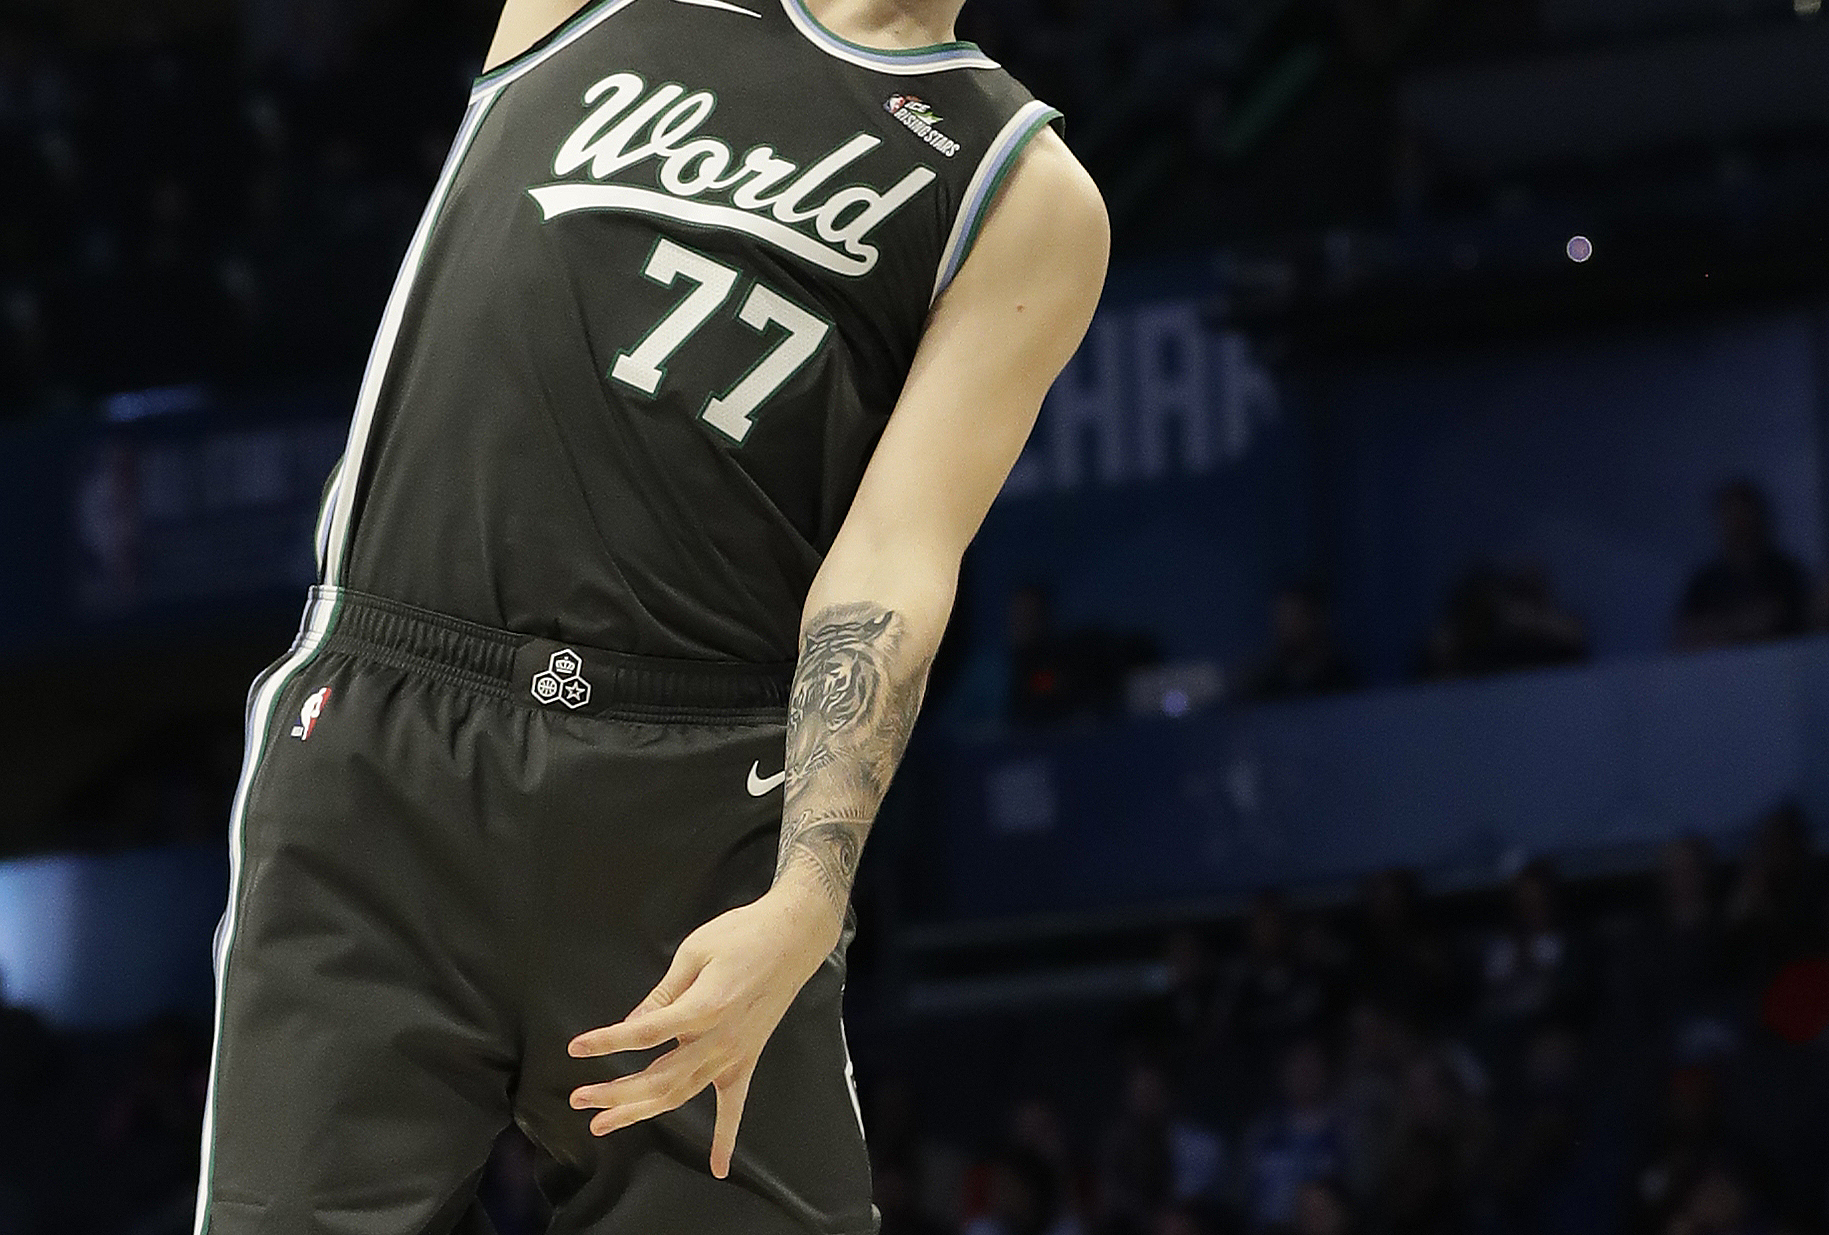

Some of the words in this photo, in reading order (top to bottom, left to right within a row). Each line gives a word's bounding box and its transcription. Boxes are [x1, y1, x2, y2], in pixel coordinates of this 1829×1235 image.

[551, 72, 937, 264] World
[893, 107, 932, 138] RISING
[923, 129, 961, 158] STARS
[609, 237, 832, 445] 77
